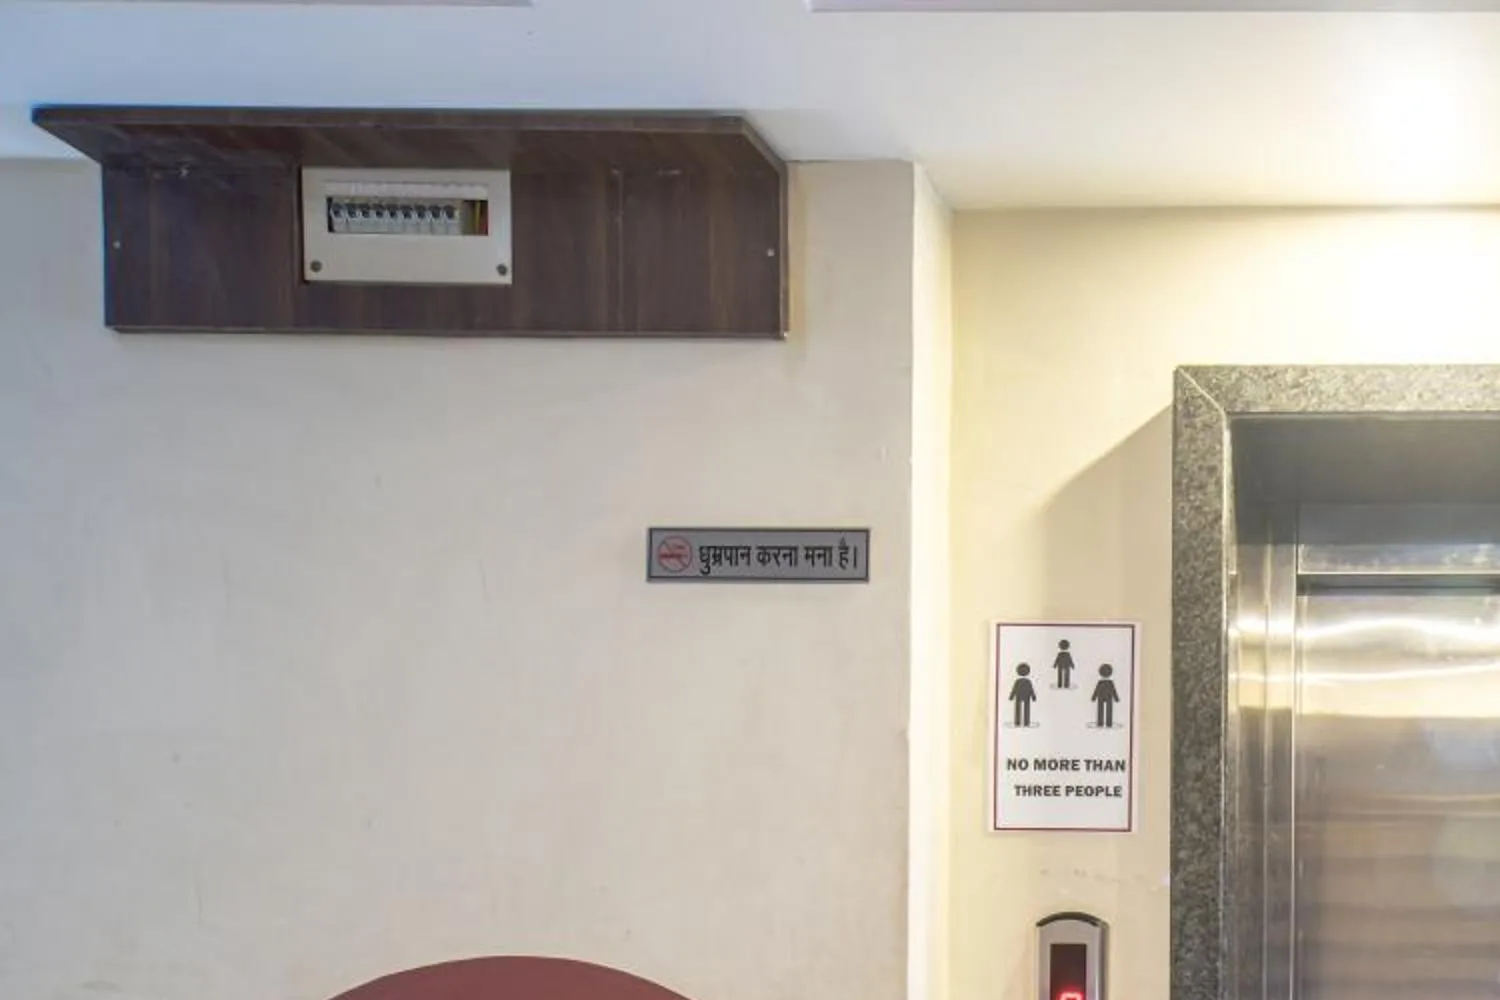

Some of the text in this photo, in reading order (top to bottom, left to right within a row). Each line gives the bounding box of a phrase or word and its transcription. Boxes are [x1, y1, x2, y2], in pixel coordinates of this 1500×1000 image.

[756, 545, 797, 567] करना
[803, 545, 832, 567] मना
[1007, 758, 1126, 772] NO MORE THAN
[1014, 785, 1123, 797] THREE PEOPLE
